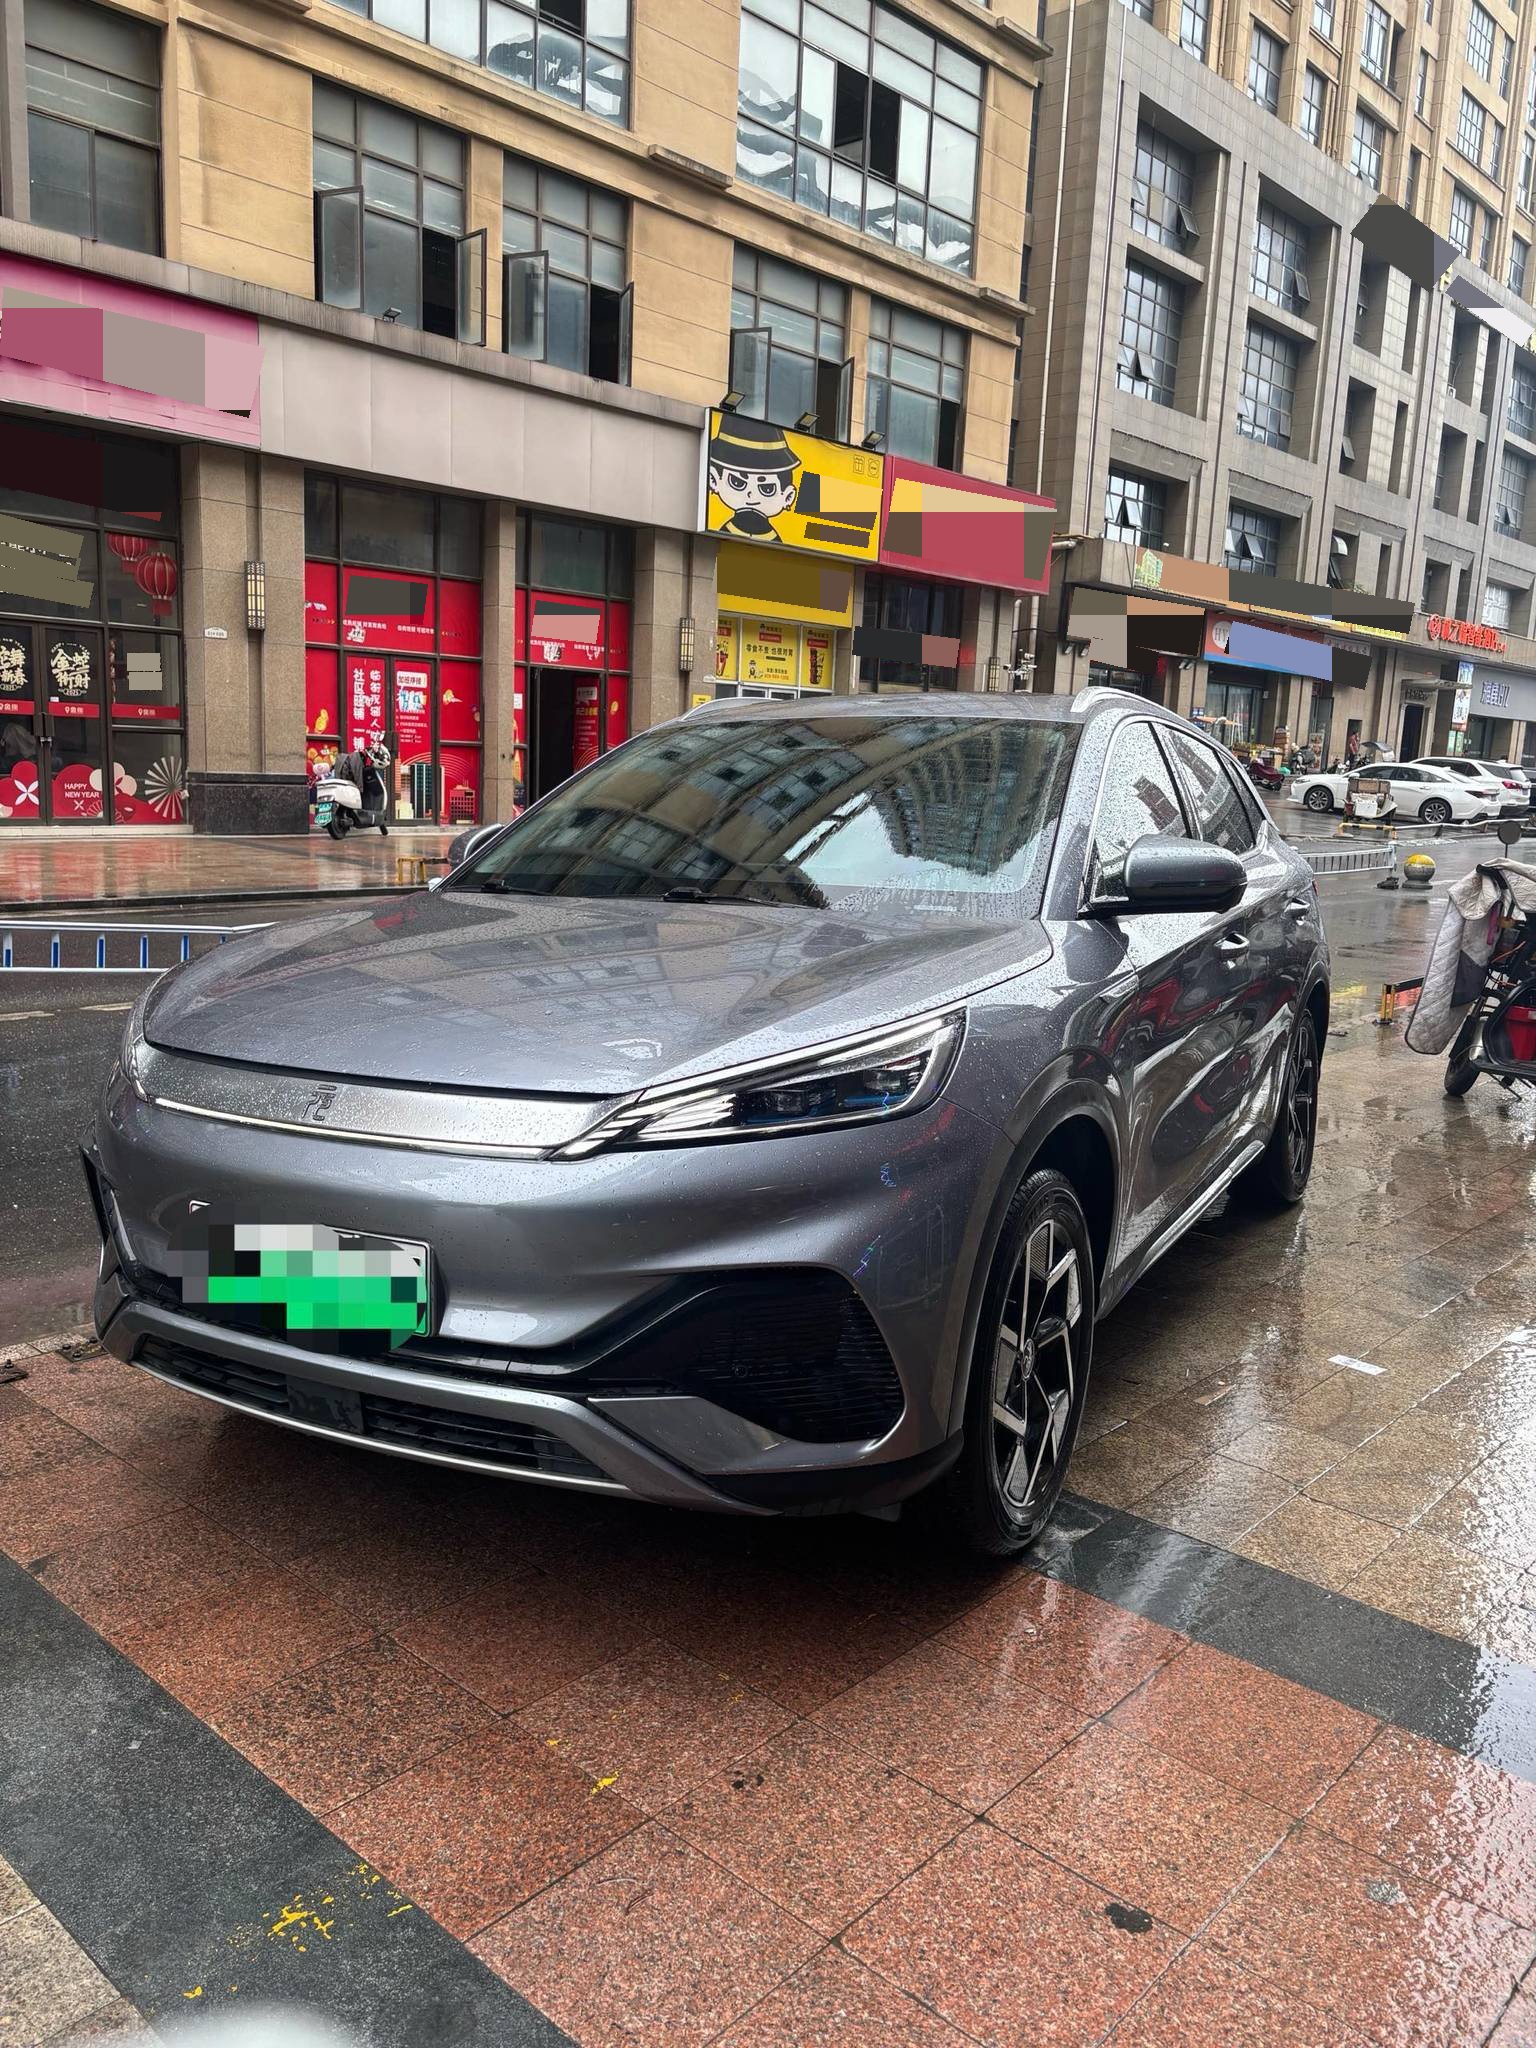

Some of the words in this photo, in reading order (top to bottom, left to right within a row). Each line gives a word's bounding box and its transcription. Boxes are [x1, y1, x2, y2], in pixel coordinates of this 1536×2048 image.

[64, 782, 88, 790] HAPPY
[64, 791, 80, 799] NEW
[82, 791, 100, 799] YEAR
